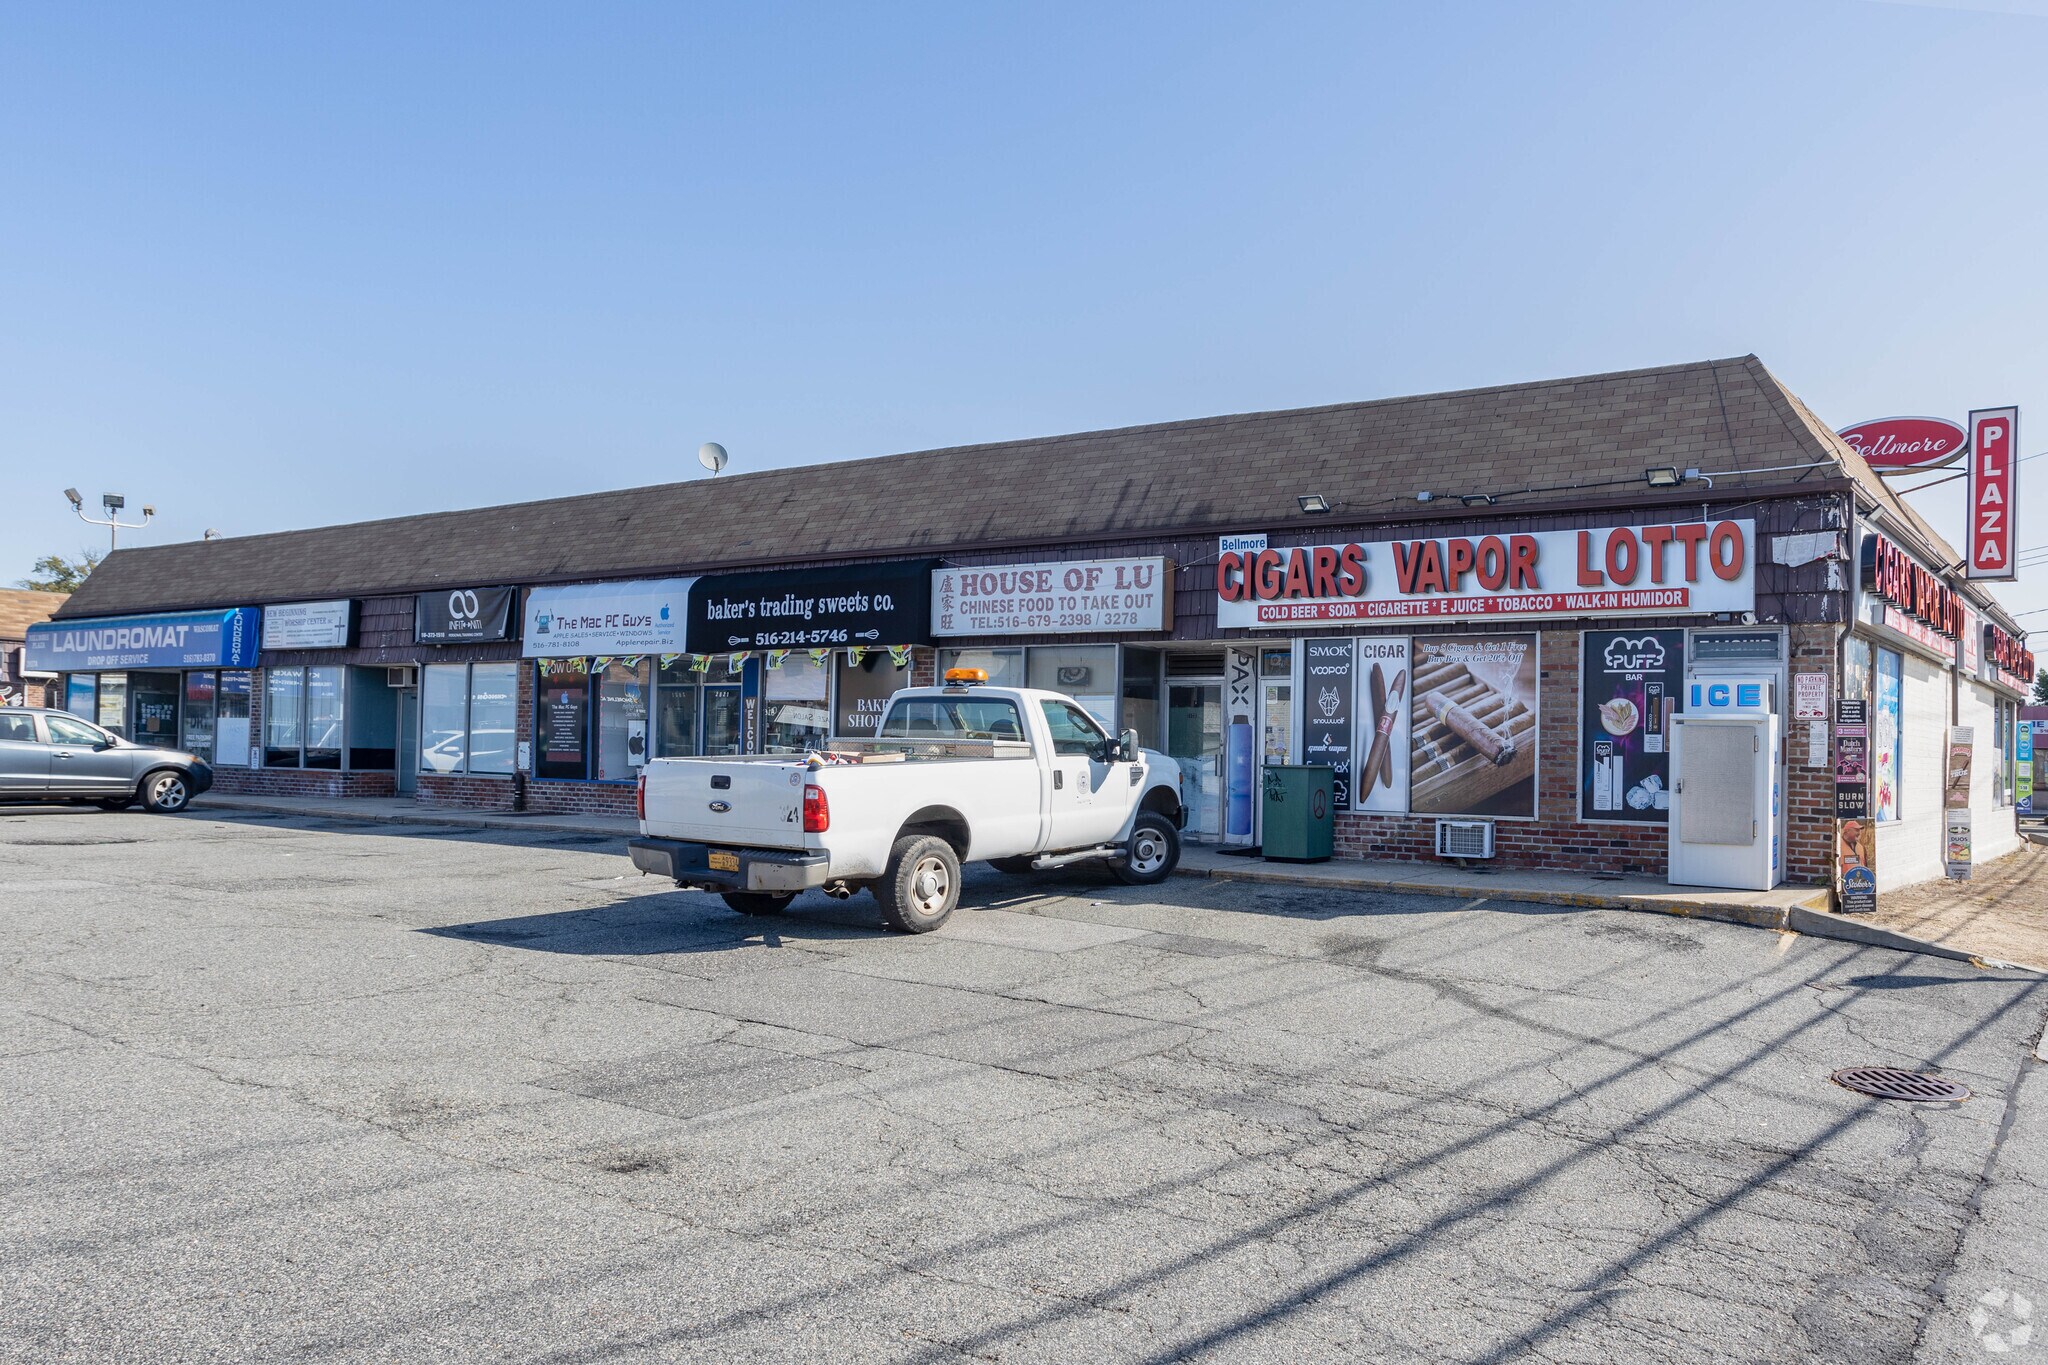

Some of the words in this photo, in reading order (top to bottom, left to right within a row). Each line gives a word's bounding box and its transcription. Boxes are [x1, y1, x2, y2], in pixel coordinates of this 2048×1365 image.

[1841, 433, 1948, 456] Bellmore
[1979, 426, 2003, 562] PLAZA
[1222, 538, 1266, 550] Bellmore
[1217, 543, 1367, 601] CIGARS
[1392, 535, 1541, 594] VAPOR
[1577, 520, 1745, 587] LOTTO
[1875, 533, 1911, 610] CIGARS
[959, 569, 1054, 597] HOUSE
[1063, 566, 1104, 592] OF
[1114, 564, 1155, 590] LU
[707, 597, 756, 621] baker's
[760, 594, 815, 620] trading
[818, 590, 869, 614] sweets
[873, 594, 895, 612] co.
[960, 598, 1014, 615] CHINESE
[1018, 597, 1054, 613] FOOD
[1058, 596, 1077, 611] TO
[1080, 594, 1119, 610] TAKE
[1123, 593, 1154, 609] OUT
[1261, 606, 1290, 620] COLD
[1291, 604, 1318, 619] BEER
[1328, 604, 1357, 617] SODA
[1368, 600, 1429, 616] CIGARETTE
[1440, 600, 1448, 614] E
[1450, 599, 1484, 613] JUICE
[1496, 596, 1553, 612] TOBACCO
[1565, 592, 1618, 609] WALK-IN
[1621, 590, 1683, 607] HUMIDOR
[266, 610, 278, 618] NEW
[278, 608, 307, 617] BEGINNING
[970, 613, 1092, 629] TEL:516-679-2398
[1104, 612, 1138, 626] 3278
[193, 624, 220, 633] WASCOMAT
[284, 618, 306, 626] WORSHIP
[306, 617, 326, 626] CENTER
[556, 616, 577, 630] The
[580, 616, 602, 629] Mac
[605, 614, 620, 628] PC
[622, 614, 652, 628] Guys
[52, 625, 190, 652] LAUNDROMAT
[232, 608, 243, 665] LAUNDROMAT
[616, 639, 674, 647] Applerepair.Biz
[755, 629, 848, 646] 516-214-5746
[532, 640, 580, 649] 516-781-8108
[1310, 646, 1350, 658] SMOK
[1364, 644, 1405, 659] CIGAR
[1423, 644, 1440, 654] Buy
[1440, 643, 1446, 652] 5
[1447, 642, 1474, 653] Cigars
[1475, 642, 1482, 652] &
[1484, 642, 1499, 651] Get
[1500, 642, 1506, 651] 1
[1507, 641, 1528, 651] Free
[88, 656, 106, 666] DROP
[106, 654, 119, 665] OFF
[120, 654, 148, 664] SERVICE
[1427, 654, 1444, 665] Buy
[1446, 654, 1461, 663] Box
[1462, 654, 1470, 662] &
[1472, 654, 1487, 662] Get
[1488, 653, 1506, 662] 20%
[1508, 652, 1524, 664] Off
[1614, 654, 1656, 669] PUFF
[1232, 650, 1250, 705] PAX
[1310, 666, 1347, 675] VOOPOO
[1805, 676, 1825, 684] PARKING
[1691, 684, 1761, 707] ICE
[1313, 716, 1345, 724] snowwolf
[712, 802, 725, 811] Ford
